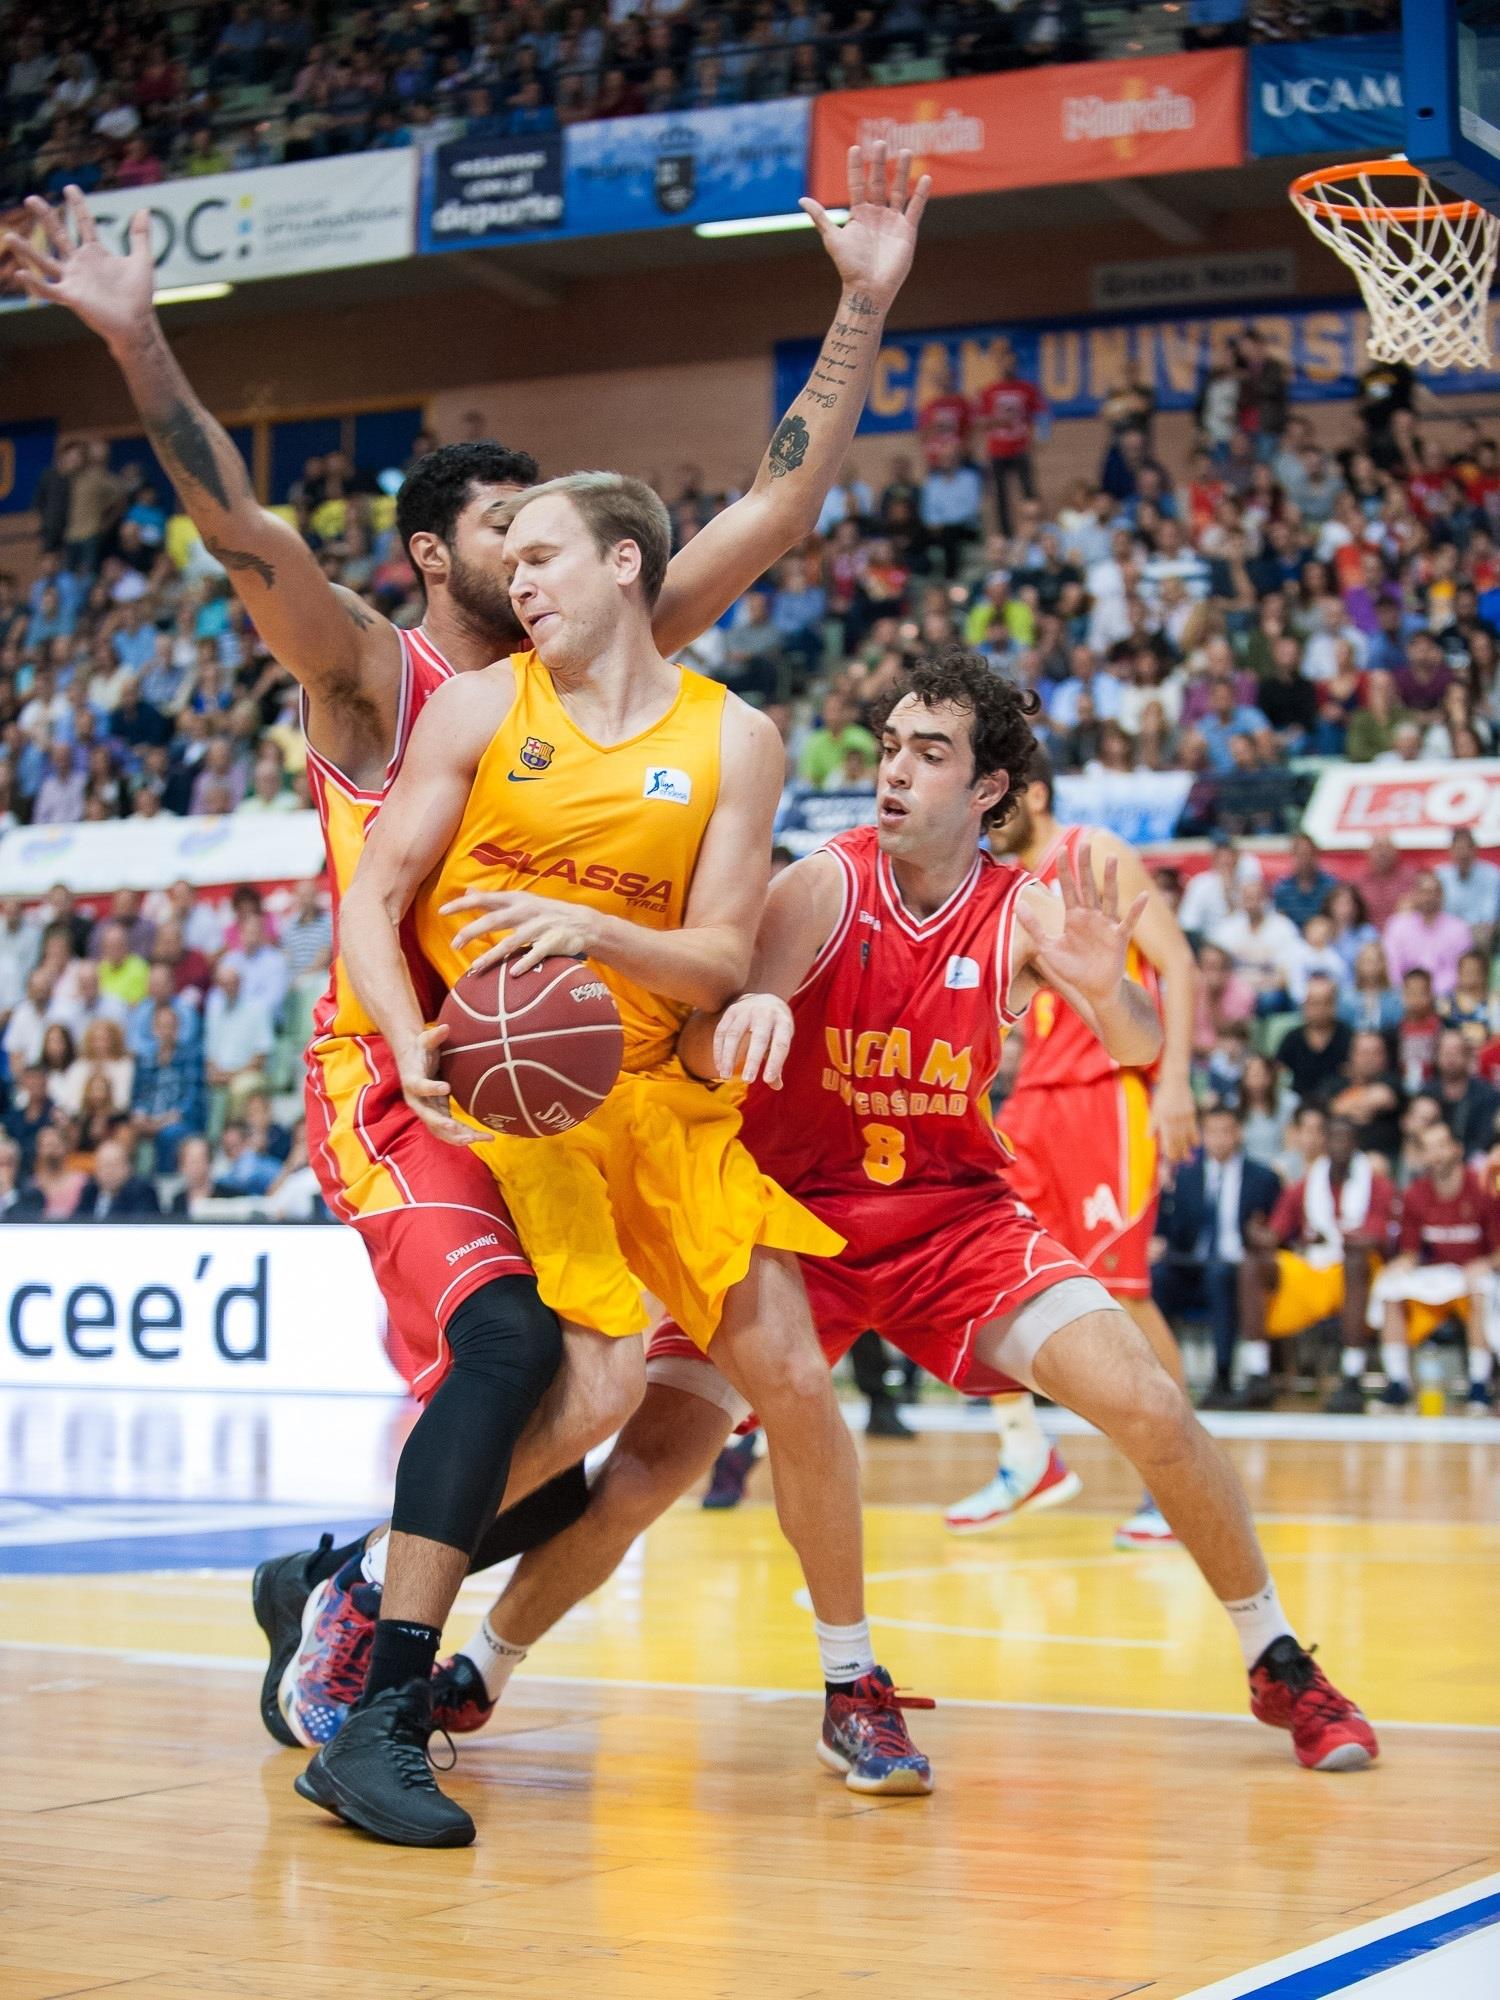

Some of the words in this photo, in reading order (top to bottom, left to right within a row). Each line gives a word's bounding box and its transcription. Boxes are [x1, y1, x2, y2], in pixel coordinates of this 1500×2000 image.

[1262, 73, 1403, 117] UCAM
[516, 852, 673, 904] LASSA
[625, 897, 668, 914] TYRES
[825, 1026, 973, 1092] UCAM
[862, 1122, 907, 1186] 8
[445, 1232, 499, 1267] SPALDING
